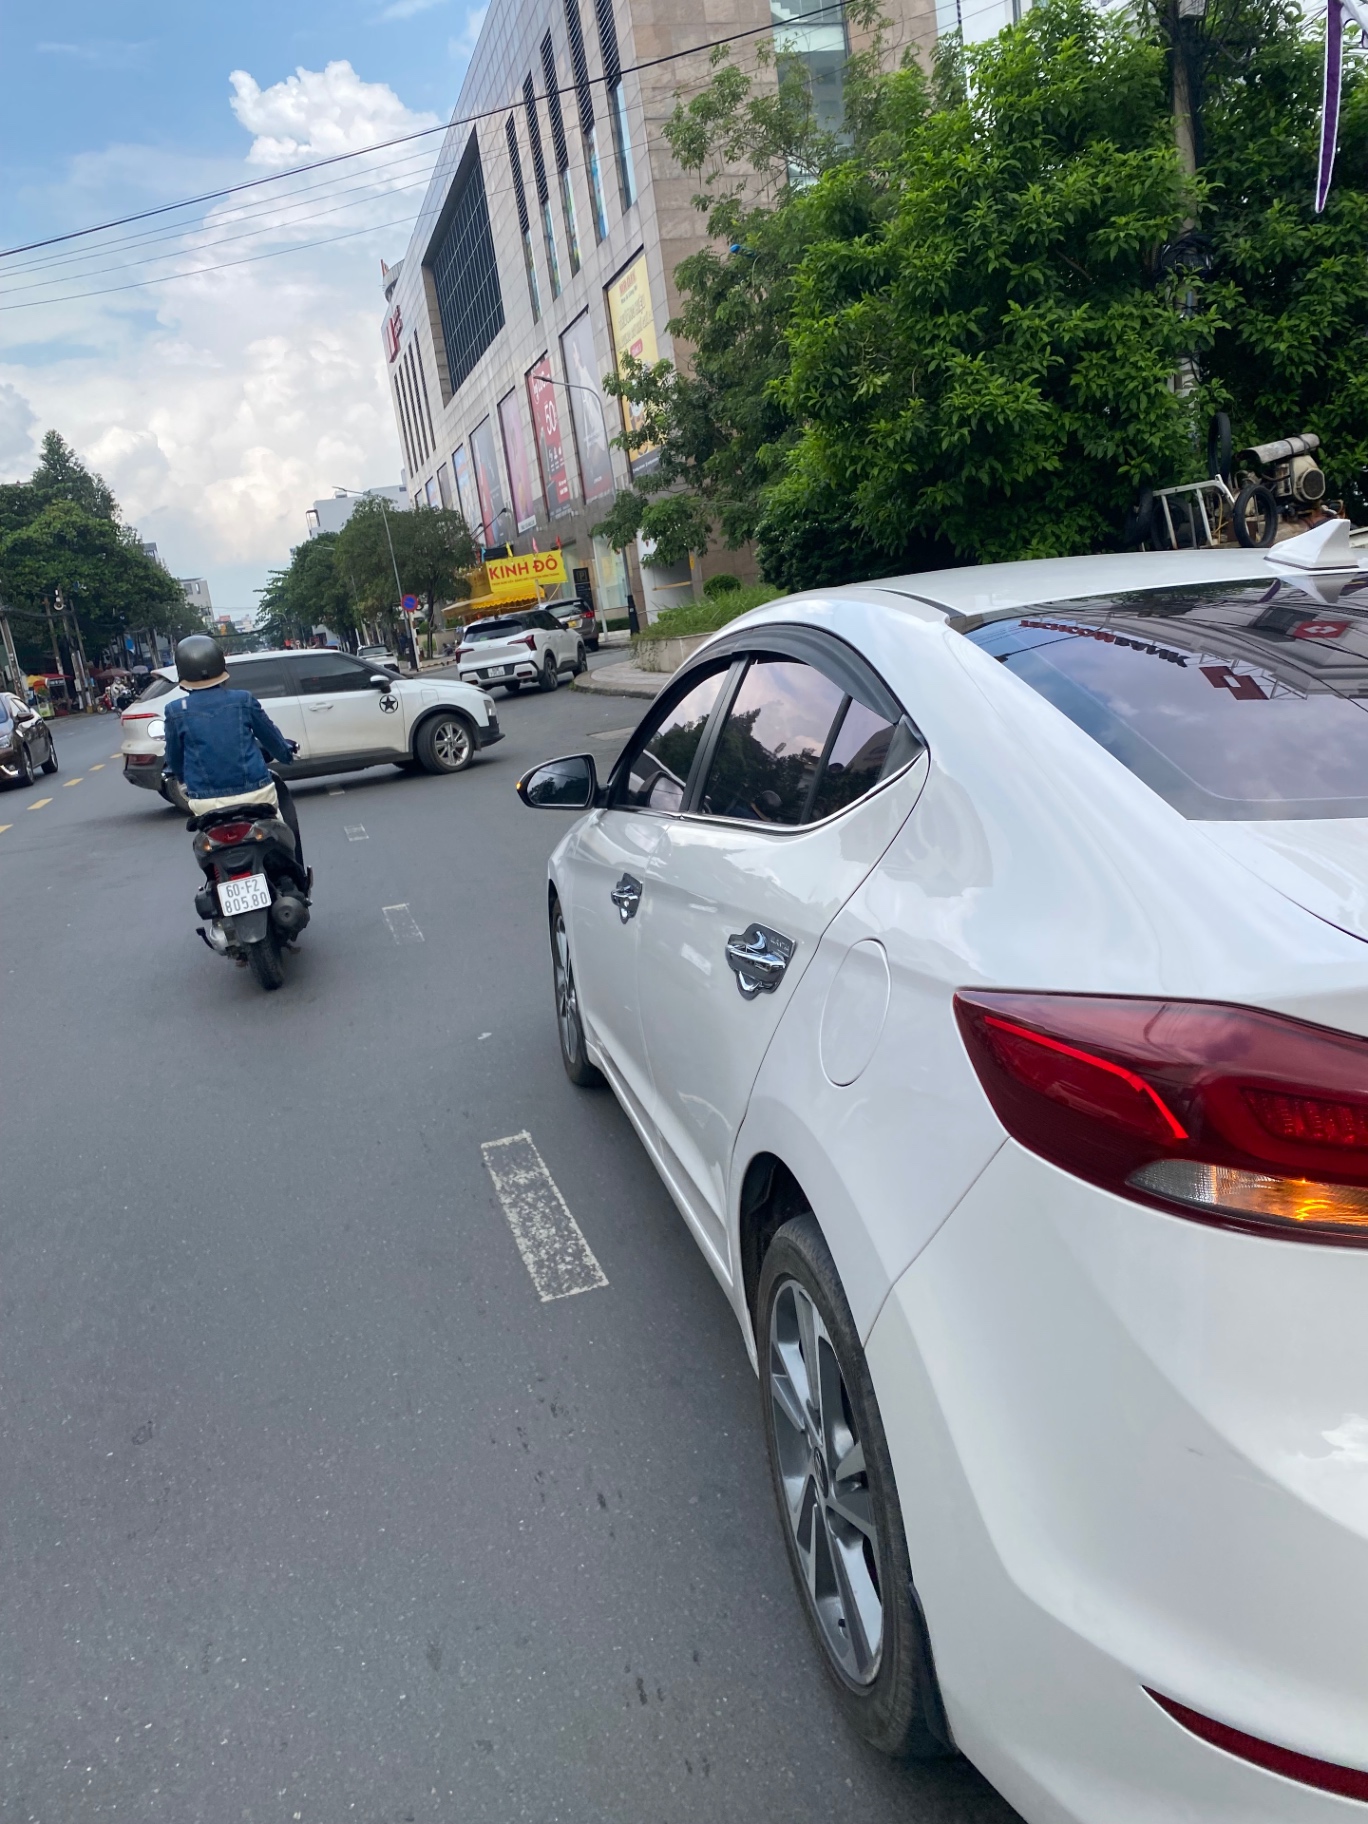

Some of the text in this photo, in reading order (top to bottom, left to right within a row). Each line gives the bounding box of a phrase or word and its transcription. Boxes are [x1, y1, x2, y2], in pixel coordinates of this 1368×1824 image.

[488, 561, 530, 580] KINH
[532, 554, 558, 573] ĐÔ
[225, 878, 260, 898] 60-F2
[224, 891, 268, 914] 805.80
